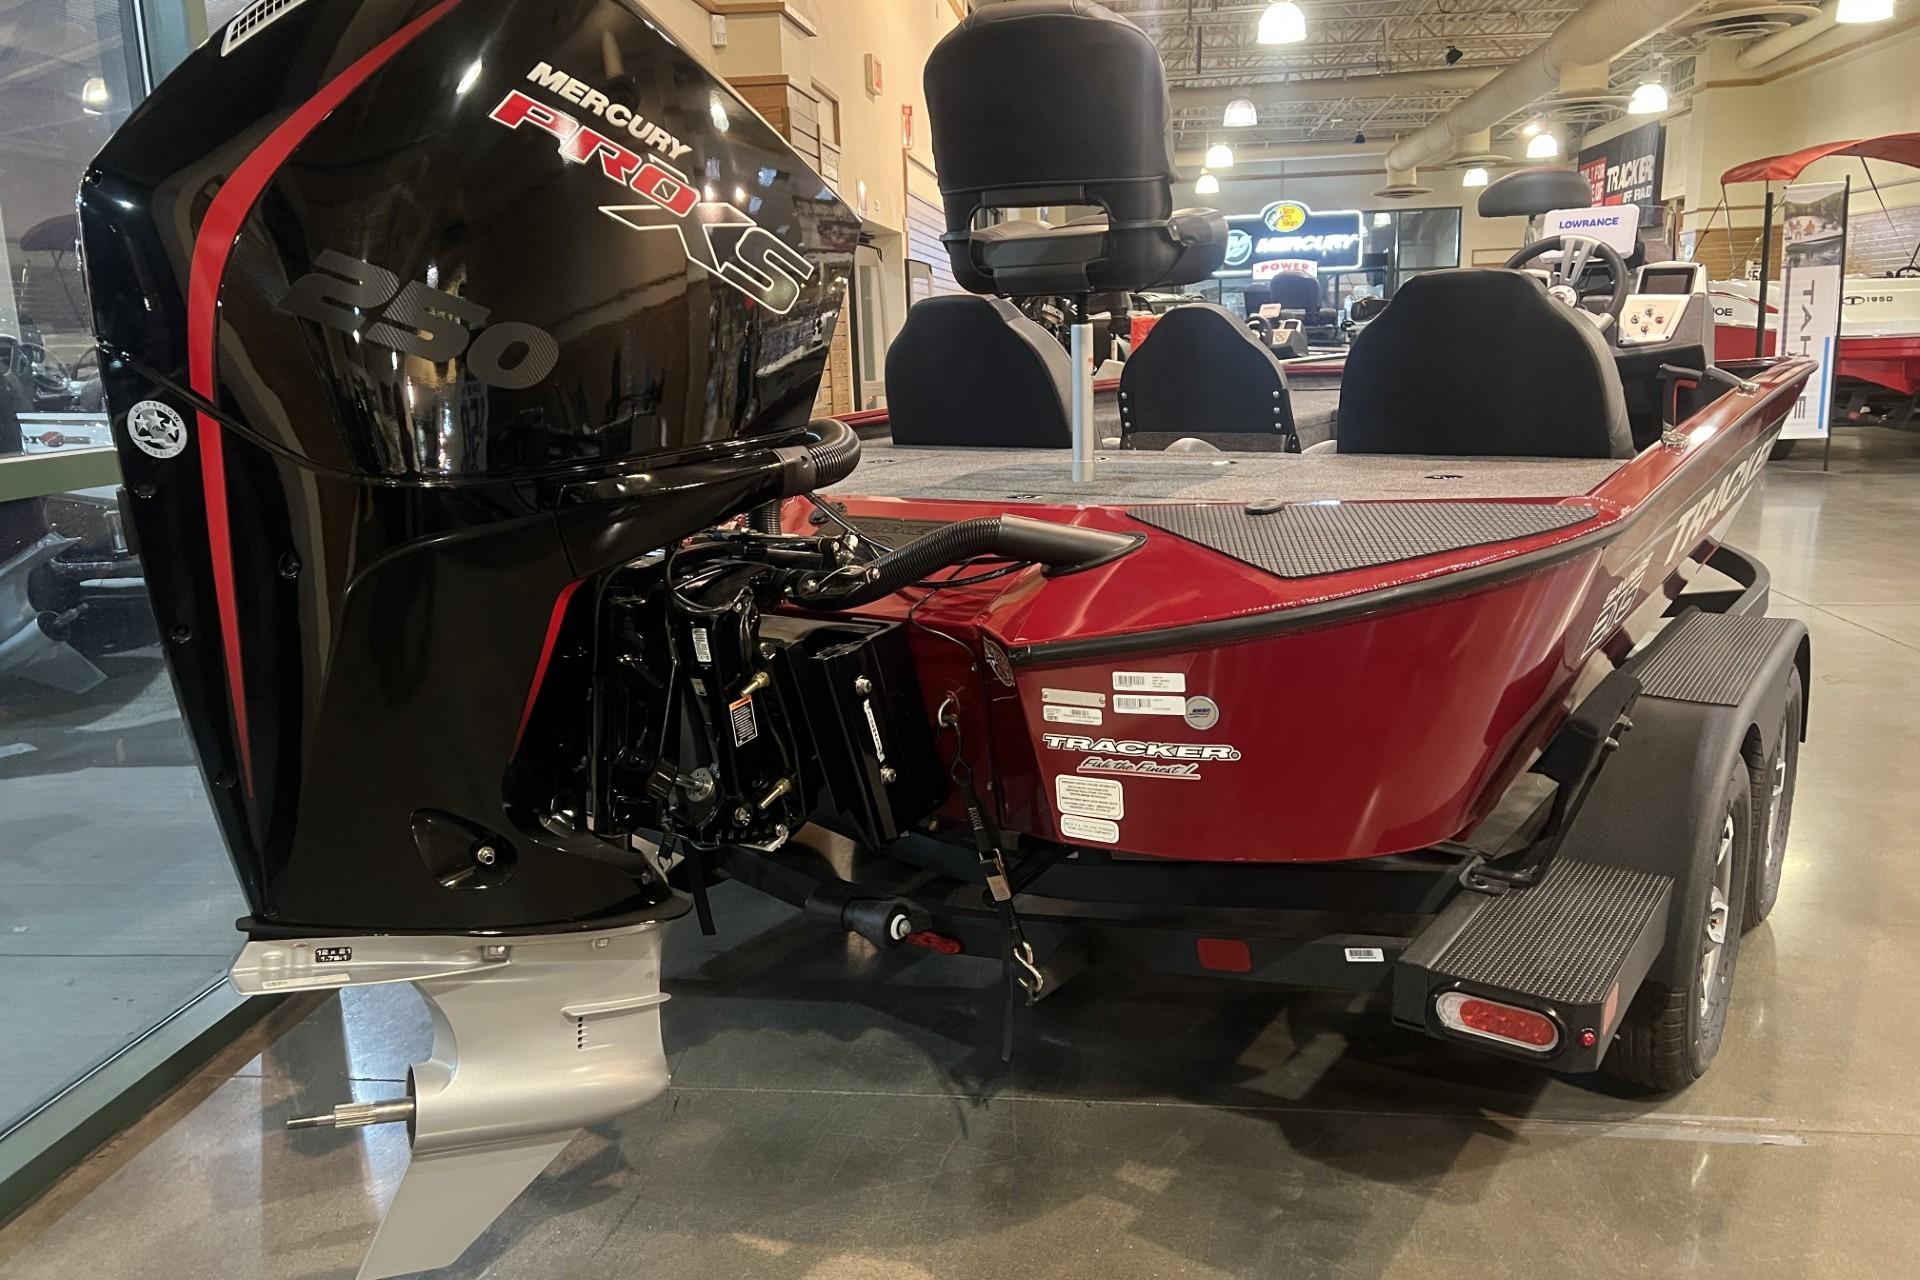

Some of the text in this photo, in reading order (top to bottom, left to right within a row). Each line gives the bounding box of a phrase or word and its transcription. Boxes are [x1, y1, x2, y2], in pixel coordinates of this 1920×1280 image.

[527, 61, 692, 160] MERCURY
[1606, 154, 1655, 194] TRACKER
[488, 88, 814, 315] PRO XS
[1558, 217, 1620, 229] LOWRANCE
[1260, 261, 1310, 273] POWER
[276, 249, 560, 389] 250
[1866, 295, 1894, 303] 1950
[1793, 279, 1815, 419] TAHE
[1664, 428, 1780, 566] TRACKE
[1043, 734, 1232, 760] TRACKER
[1082, 757, 1111, 768] Fish
[1112, 759, 1134, 771] the
